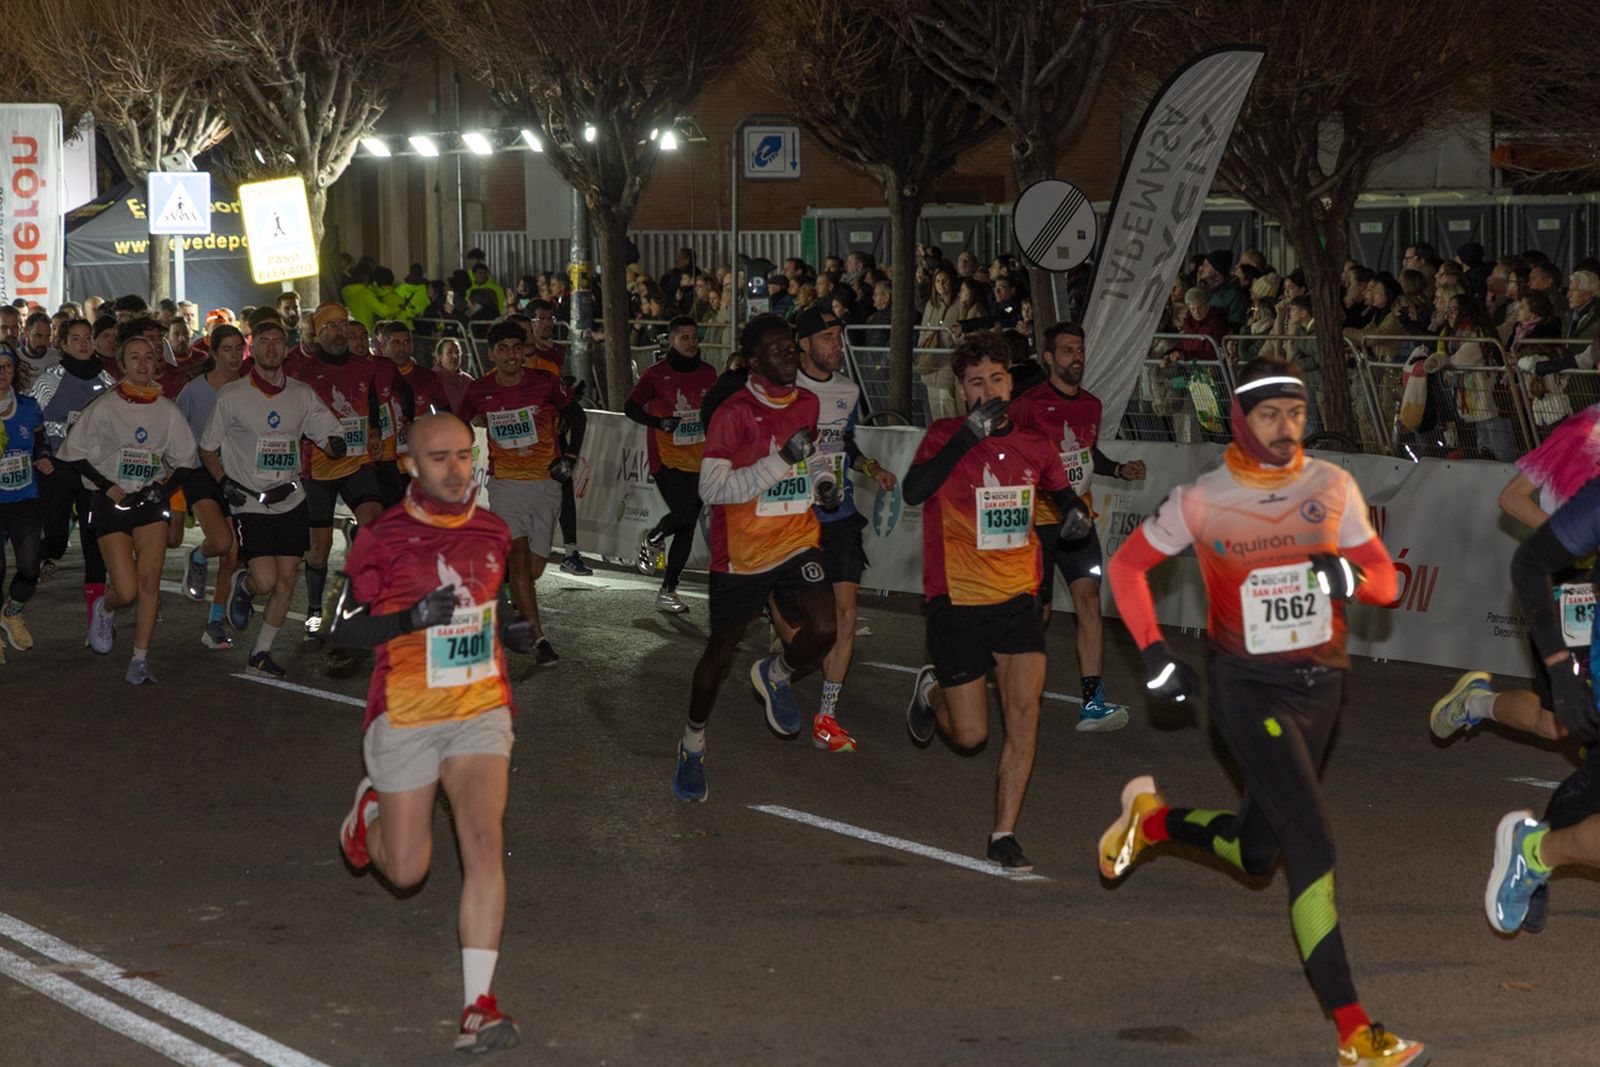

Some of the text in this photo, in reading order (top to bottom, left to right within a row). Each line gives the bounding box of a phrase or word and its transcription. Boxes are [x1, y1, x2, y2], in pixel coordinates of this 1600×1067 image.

[267, 252, 300, 265] PASO
[257, 263, 314, 281] ELEVADO
[495, 421, 530, 437] 12998
[344, 431, 365, 443] 952
[262, 453, 295, 467] 13475
[1065, 466, 1084, 482] 03
[985, 508, 1029, 528] 13330
[1261, 574, 1288, 586] NOCHE
[1252, 584, 1302, 598] SAN ANTÓN
[1261, 592, 1317, 623] 7662
[437, 627, 454, 637] SAN
[447, 635, 485, 660] 7401
